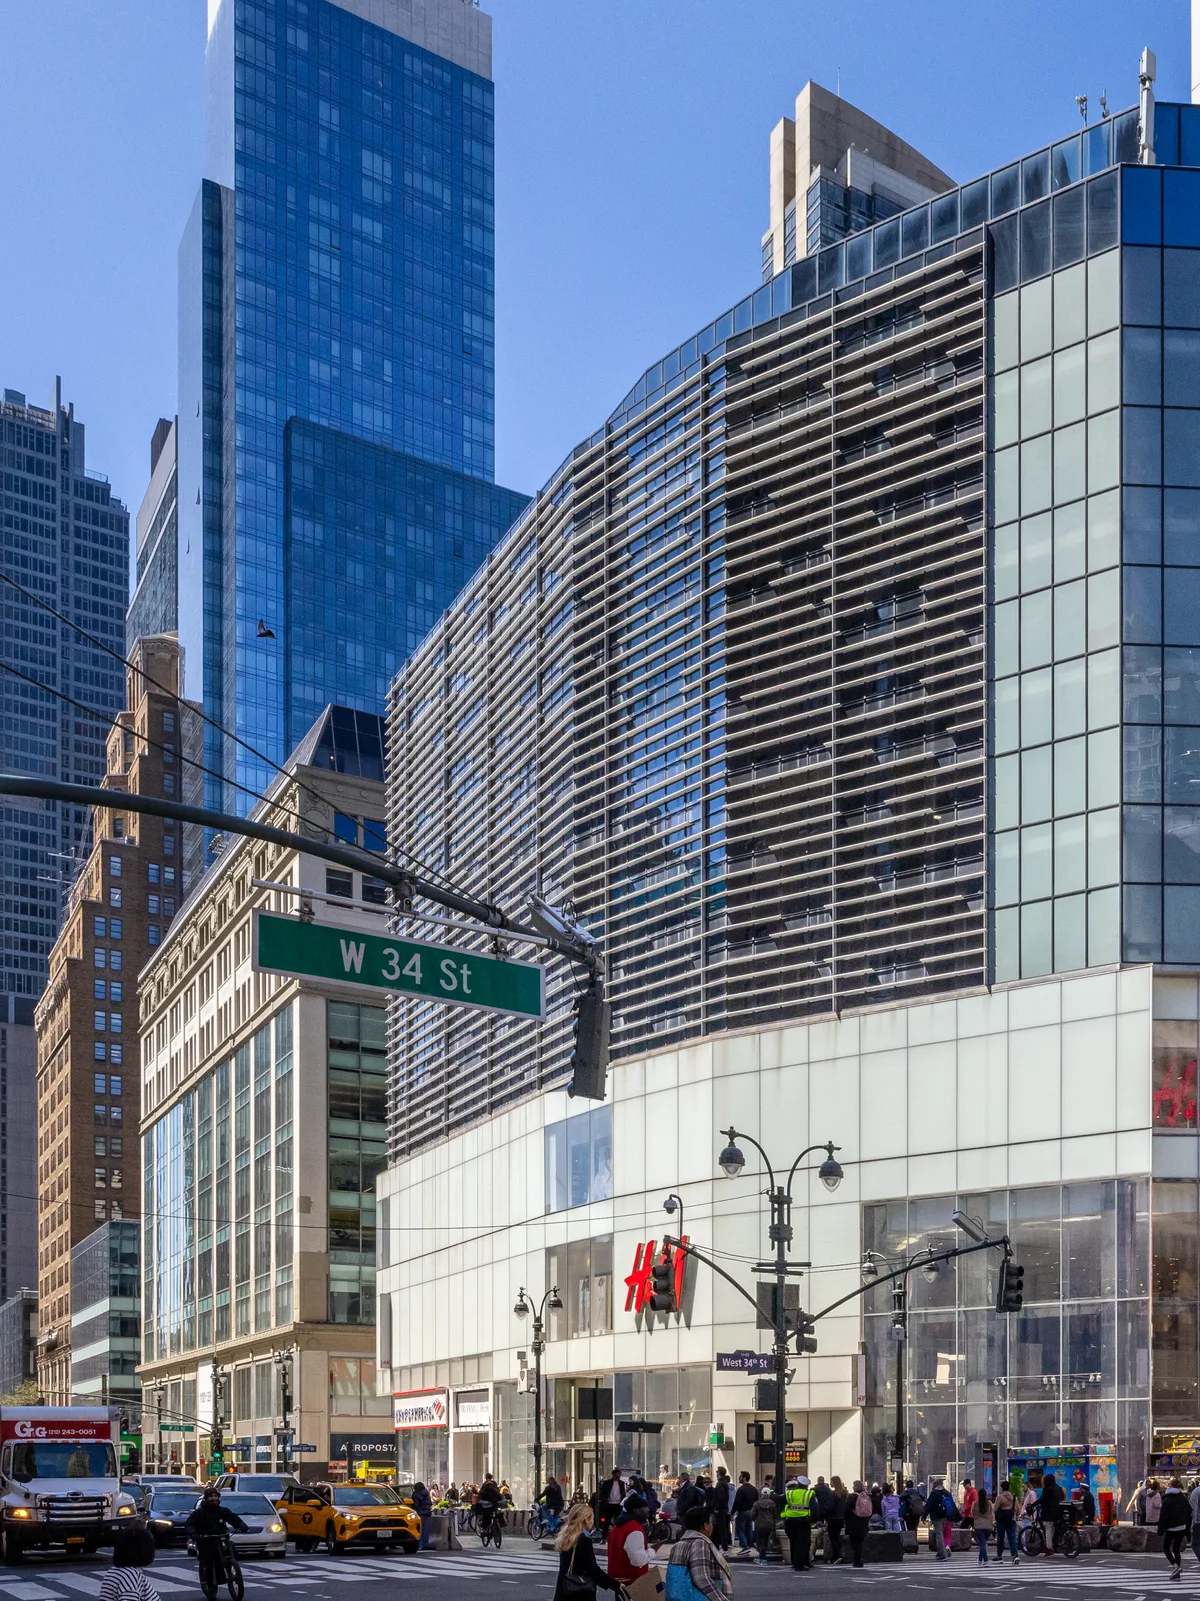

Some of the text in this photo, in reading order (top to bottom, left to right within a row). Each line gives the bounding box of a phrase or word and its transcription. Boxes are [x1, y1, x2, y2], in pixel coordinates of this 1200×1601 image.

[339, 938, 472, 994] W 34 St
[722, 1358, 768, 1368] West 34th St
[304, 1514, 311, 1523] T
